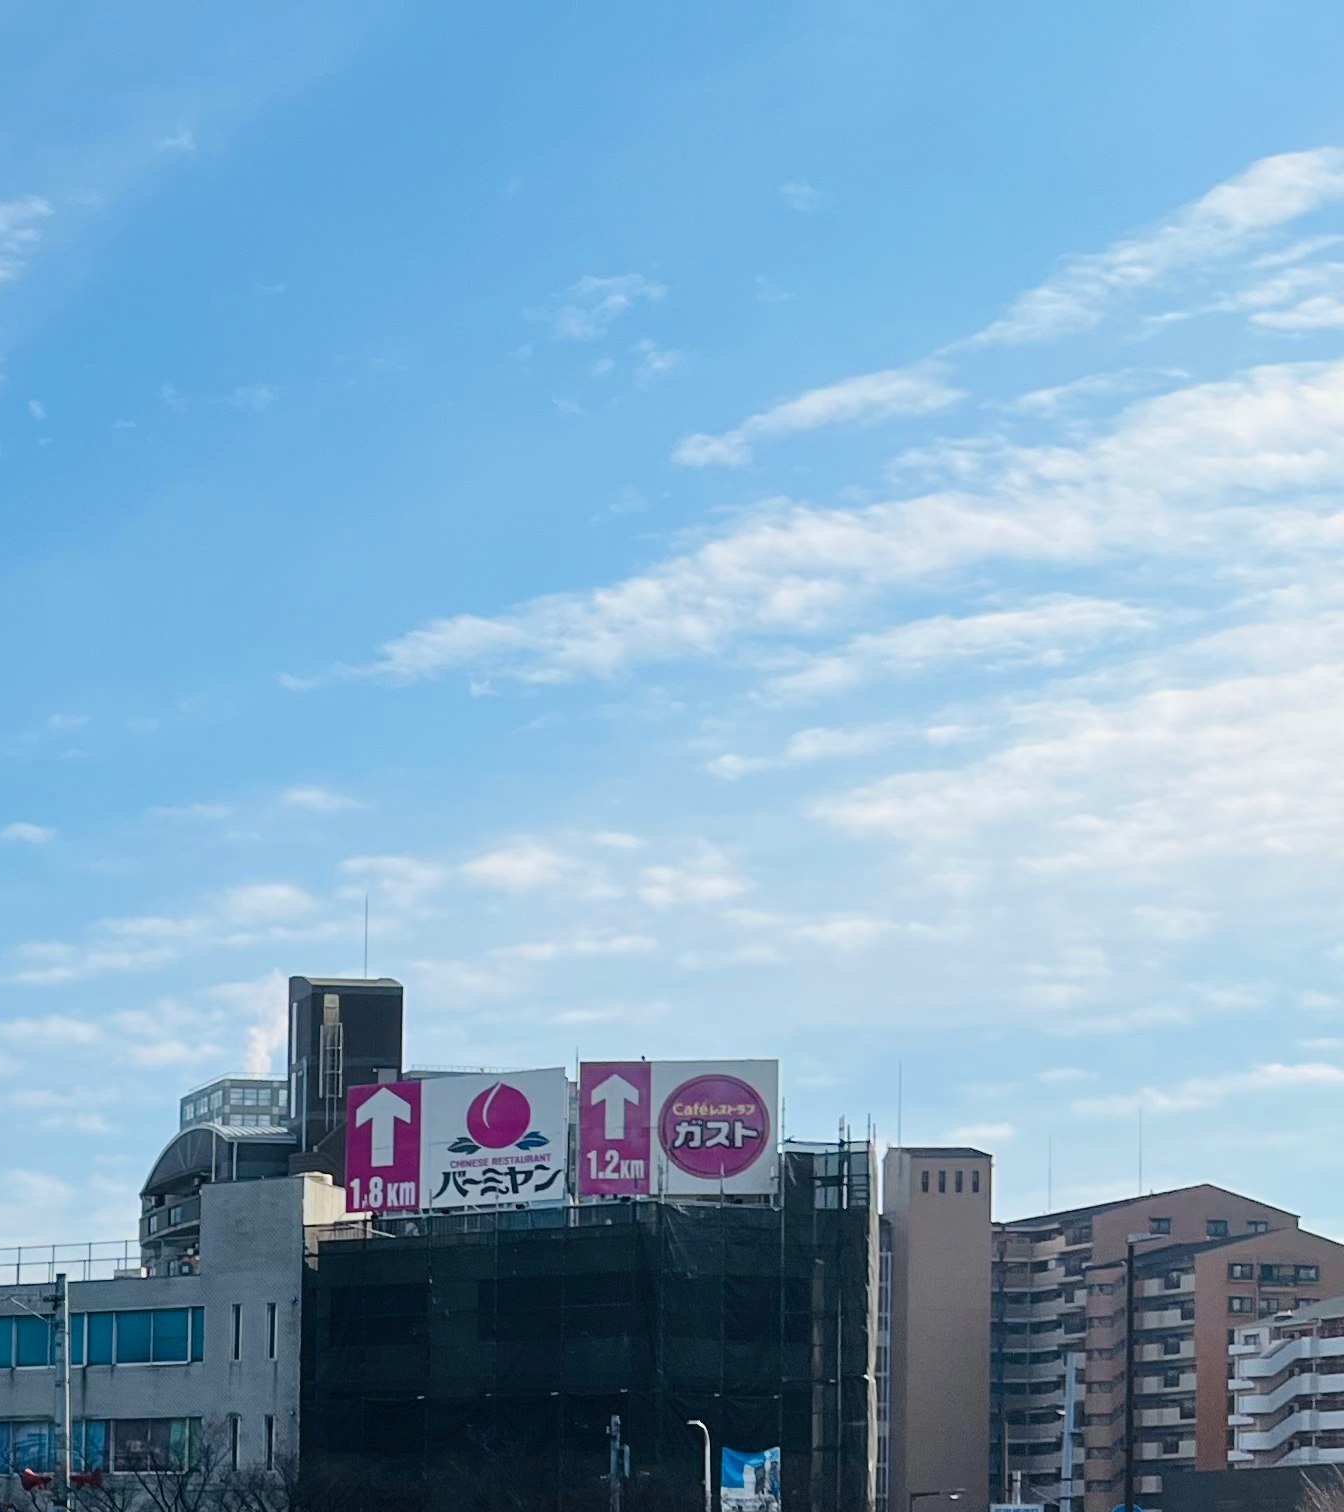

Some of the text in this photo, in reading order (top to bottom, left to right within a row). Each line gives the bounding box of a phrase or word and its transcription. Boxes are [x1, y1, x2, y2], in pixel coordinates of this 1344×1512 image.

[673, 1119, 759, 1148] ガスト
[450, 1153, 552, 1169] CHINESE RESTAURANT
[433, 1164, 563, 1199] バーミヤン
